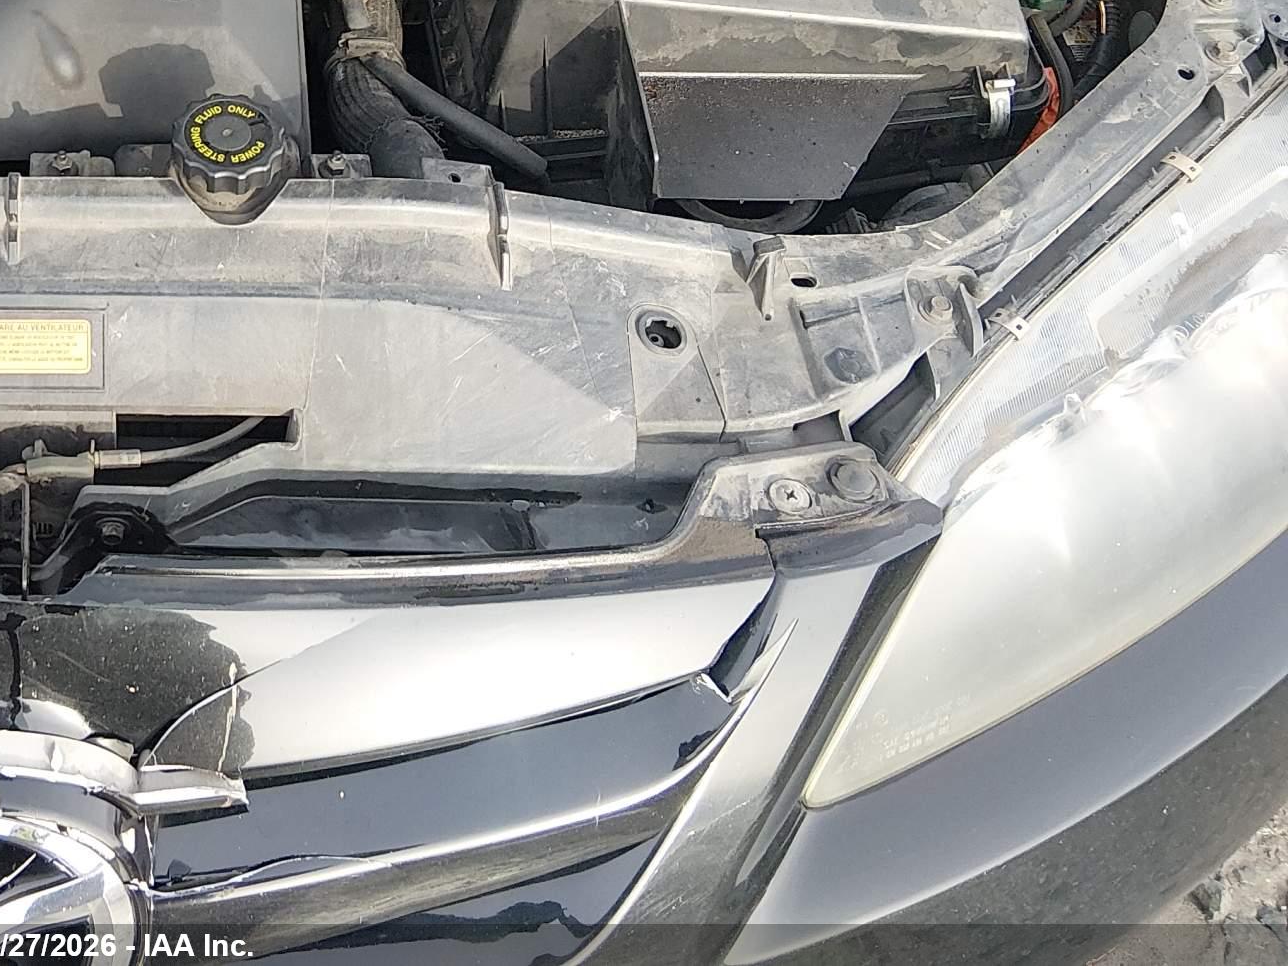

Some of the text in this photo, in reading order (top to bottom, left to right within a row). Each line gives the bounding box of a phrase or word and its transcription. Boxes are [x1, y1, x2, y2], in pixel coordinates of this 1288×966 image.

[190, 104, 266, 163] POWER STEERING FLUID ONLY
[17, 323, 29, 331] AU
[31, 323, 85, 331] VENTILATEUR
